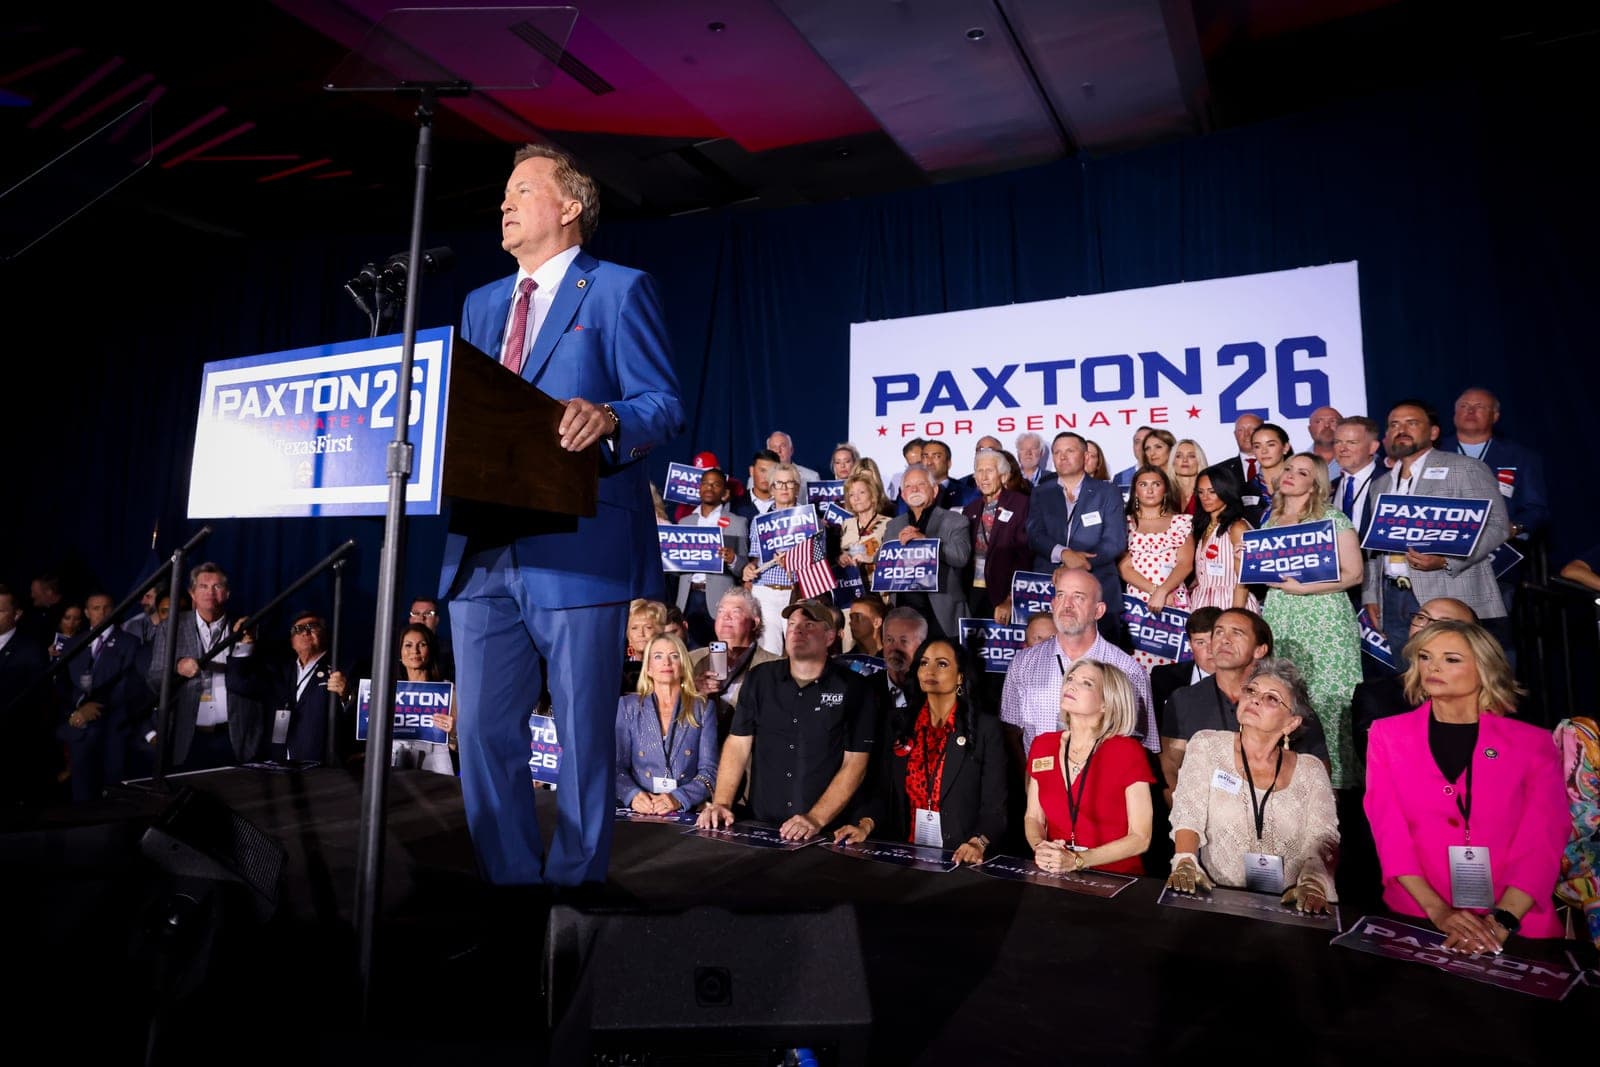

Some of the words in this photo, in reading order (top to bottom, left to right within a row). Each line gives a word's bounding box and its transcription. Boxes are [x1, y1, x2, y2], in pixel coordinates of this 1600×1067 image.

[872, 347, 1202, 416] PAXTON
[1217, 335, 1330, 424] 26
[218, 372, 369, 420] PAXTON
[901, 420, 973, 437] FOR
[997, 407, 1169, 432] SENATE
[1379, 503, 1484, 523] PAXTON
[758, 513, 814, 535] PAXTON
[659, 532, 720, 545] PAXTON
[766, 532, 806, 551] 2026
[1244, 529, 1333, 553] PAXTON
[1388, 526, 1459, 542] 2026
[668, 549, 713, 561] 2026
[879, 547, 937, 561] PAXTON
[1260, 553, 1320, 572] 2026
[883, 566, 926, 579] 2026
[1014, 579, 1055, 595] PAX
[1128, 622, 1181, 648] 2026
[980, 647, 1015, 660] 202
